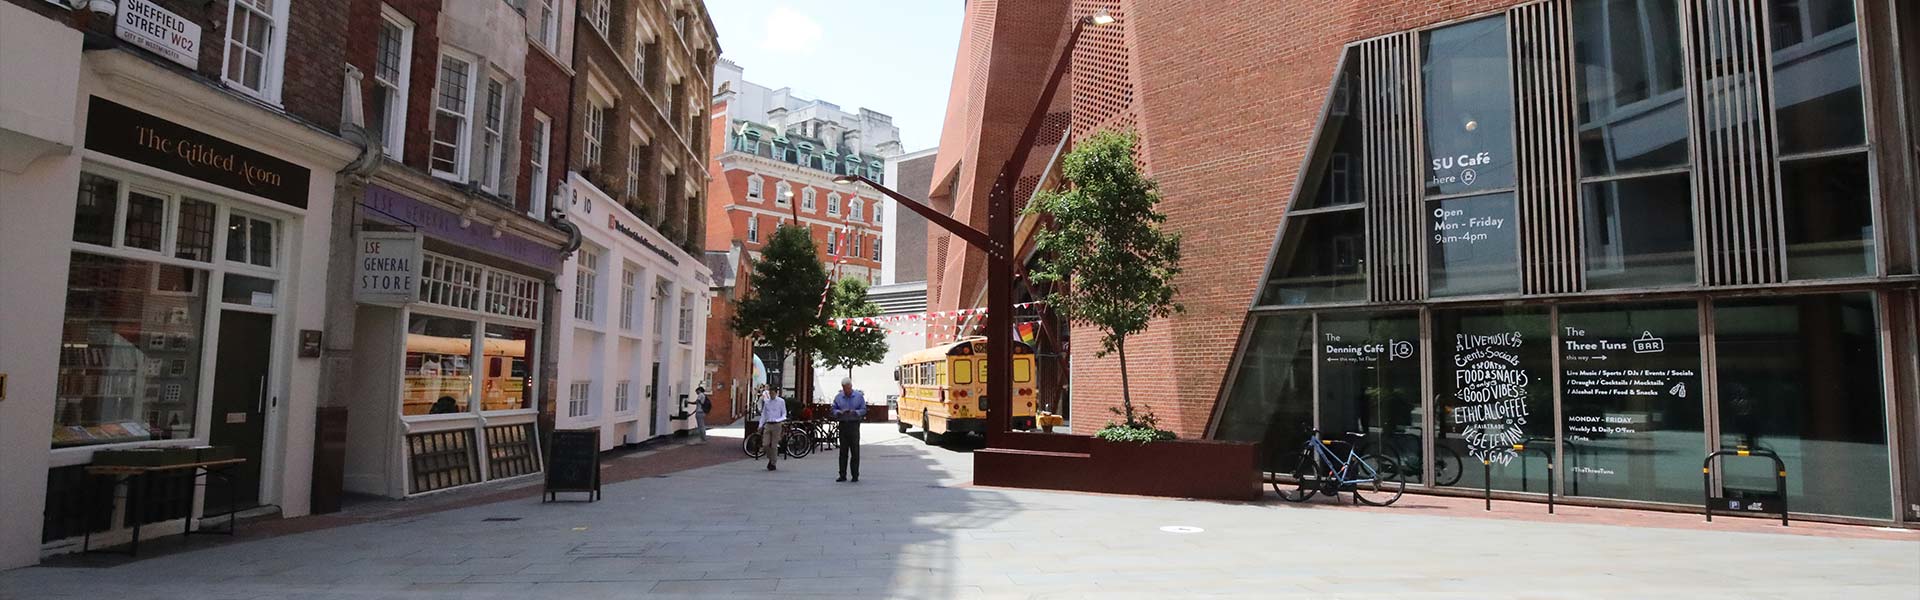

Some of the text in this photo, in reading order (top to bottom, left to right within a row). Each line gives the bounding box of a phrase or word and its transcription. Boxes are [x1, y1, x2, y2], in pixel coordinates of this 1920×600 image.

[128, 0, 185, 33] SHEFFIELD
[126, 12, 193, 52] STREET WC2
[124, 31, 136, 41] CITY
[145, 40, 179, 59] WESTMINSTER
[136, 125, 281, 186] The Gilded Acorn
[1432, 152, 1490, 171] SU Café
[1433, 175, 1456, 185] here
[572, 188, 592, 214] 9 10
[1434, 208, 1463, 220] Open
[1434, 222, 1459, 231] Mon
[1469, 217, 1504, 229] Friday
[1434, 232, 1487, 244] 9am-4pm
[365, 241, 380, 255] LSE
[363, 257, 410, 272] GENERAL
[362, 275, 411, 290] STORE
[1325, 332, 1341, 342] The
[1565, 326, 1585, 337] The
[1326, 344, 1385, 356] Denning Café
[1565, 340, 1627, 350] Three Tuns
[1637, 342, 1660, 350] BAR
[1485, 346, 1520, 366] Socials
[1463, 383, 1519, 403] GOOD VIBES
[1454, 403, 1497, 424] ETHICAL
[1568, 415, 1600, 423] MONDAY
[1568, 425, 1591, 434] Weekly
[1598, 426, 1614, 434] Daily
